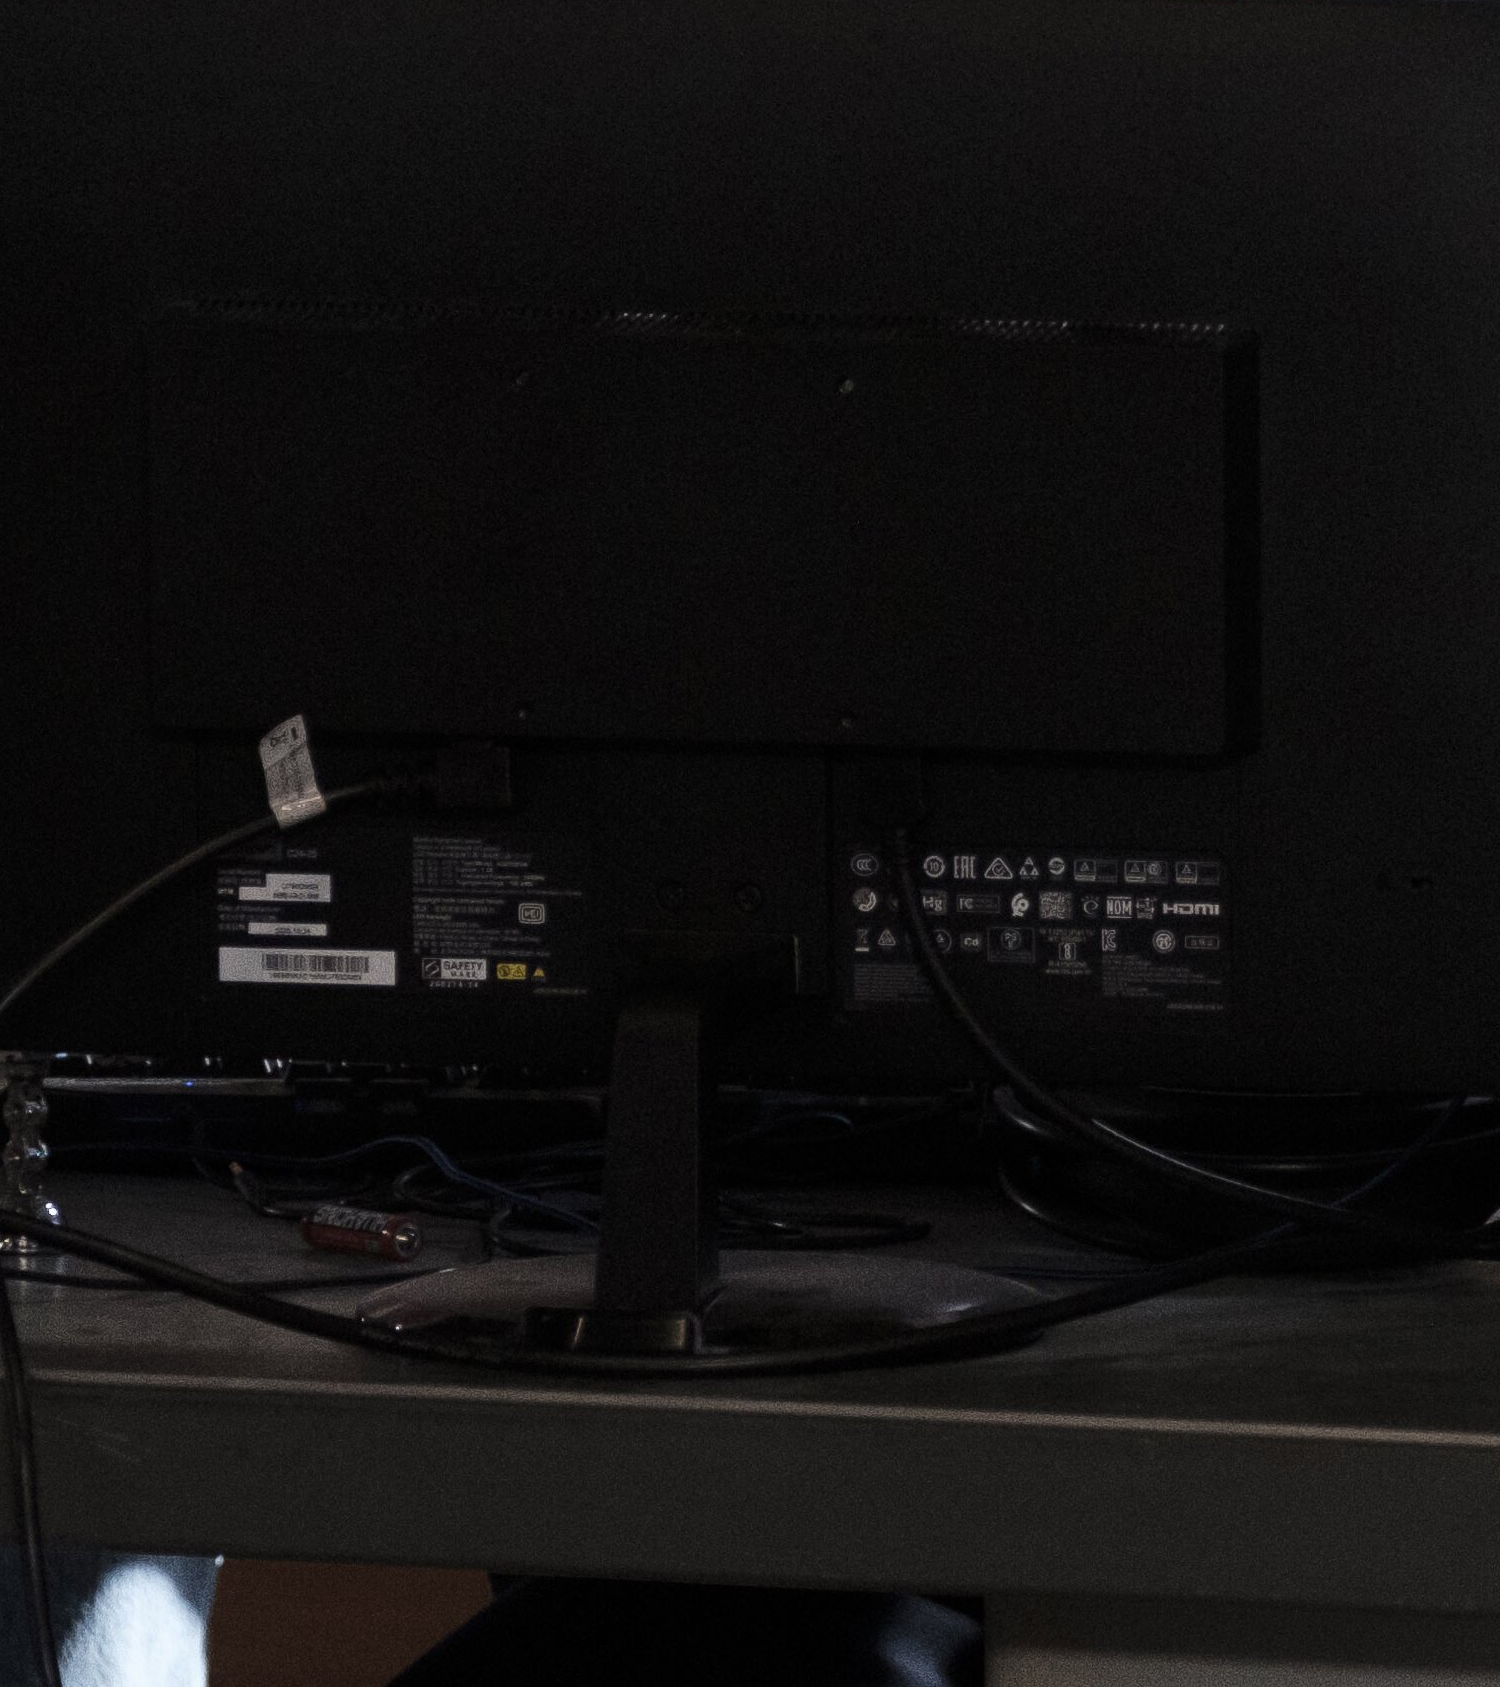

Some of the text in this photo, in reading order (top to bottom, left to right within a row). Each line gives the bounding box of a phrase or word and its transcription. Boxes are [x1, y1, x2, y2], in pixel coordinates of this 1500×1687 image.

[1106, 898, 1133, 916] NOM
[1162, 902, 1220, 916] HDMI
[443, 960, 484, 971] SAFETY
